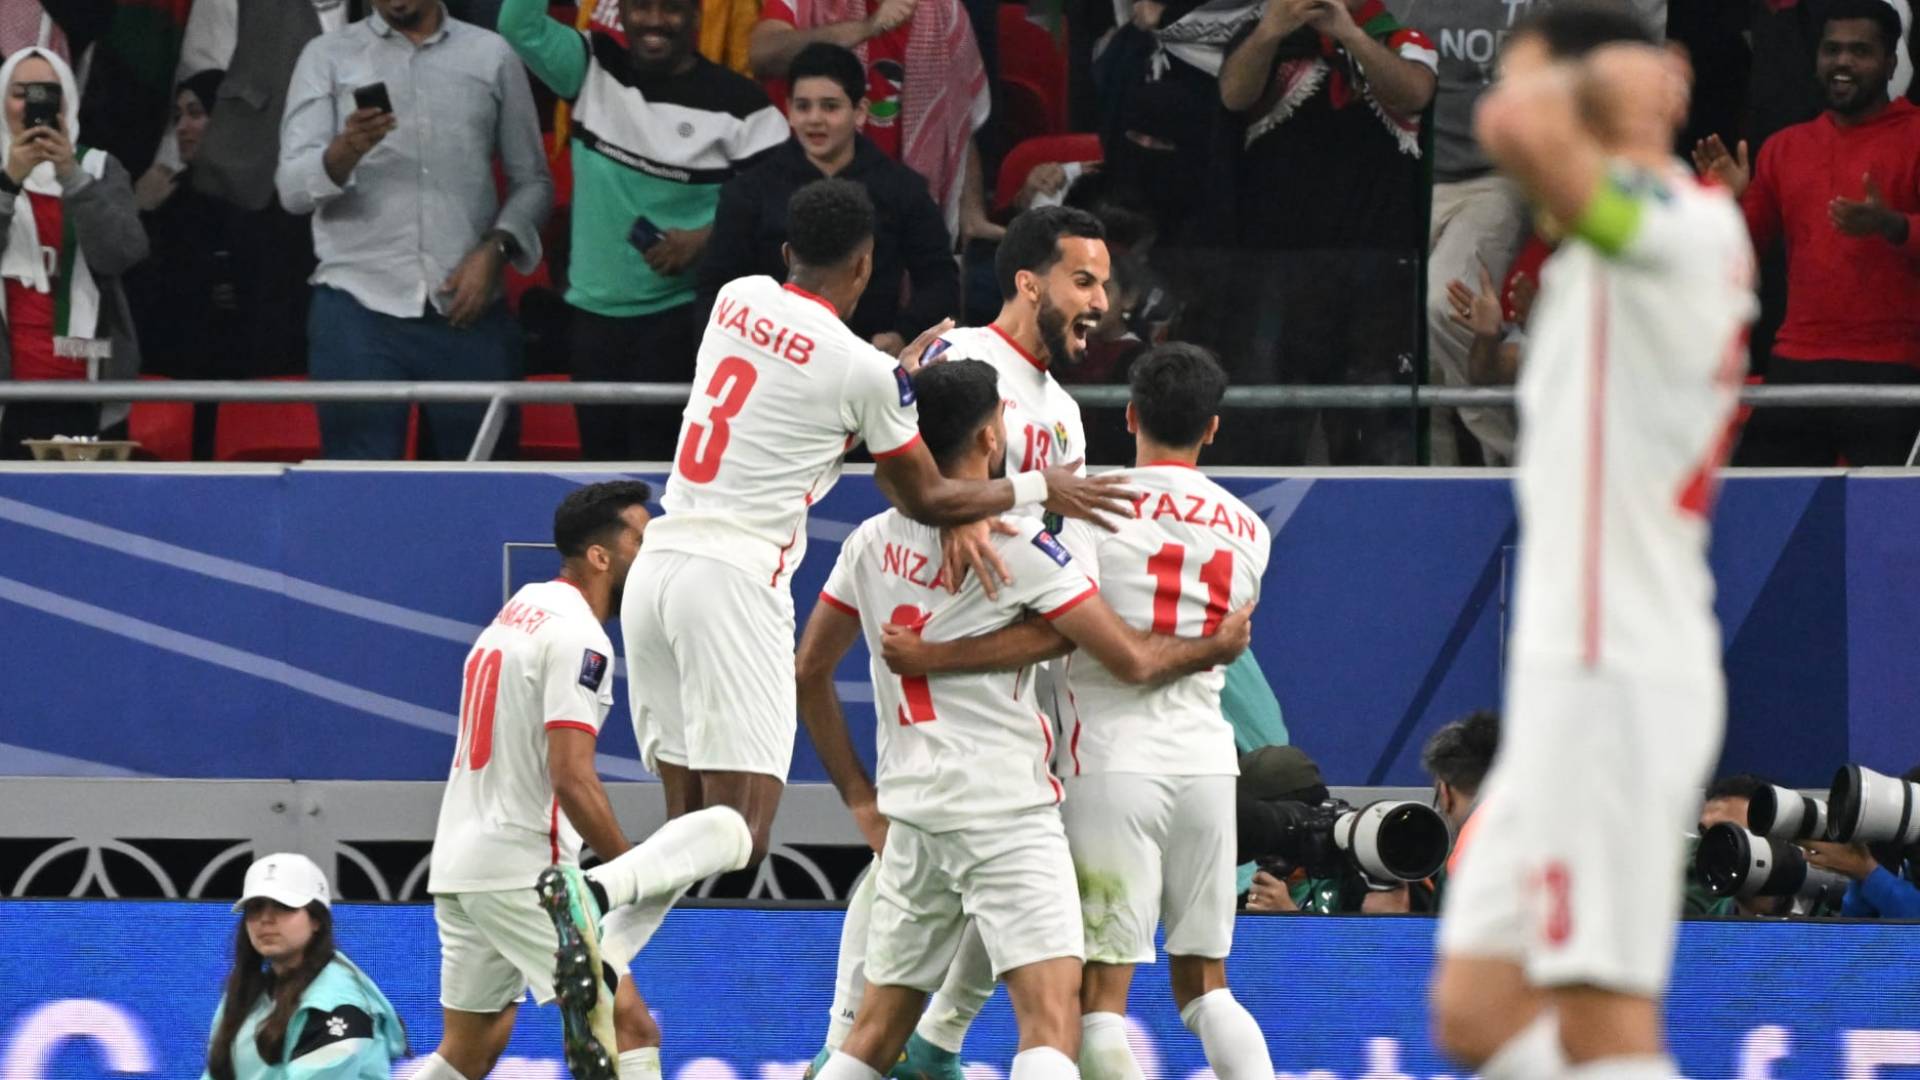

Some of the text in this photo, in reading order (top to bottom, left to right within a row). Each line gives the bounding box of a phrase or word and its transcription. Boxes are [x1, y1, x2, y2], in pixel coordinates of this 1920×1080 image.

[715, 297, 815, 365] NASIB
[679, 356, 757, 484] 3
[1131, 492, 1256, 542] YAZAN
[883, 543, 950, 592] NIZA
[1147, 543, 1233, 640] 11
[455, 648, 502, 770] 10
